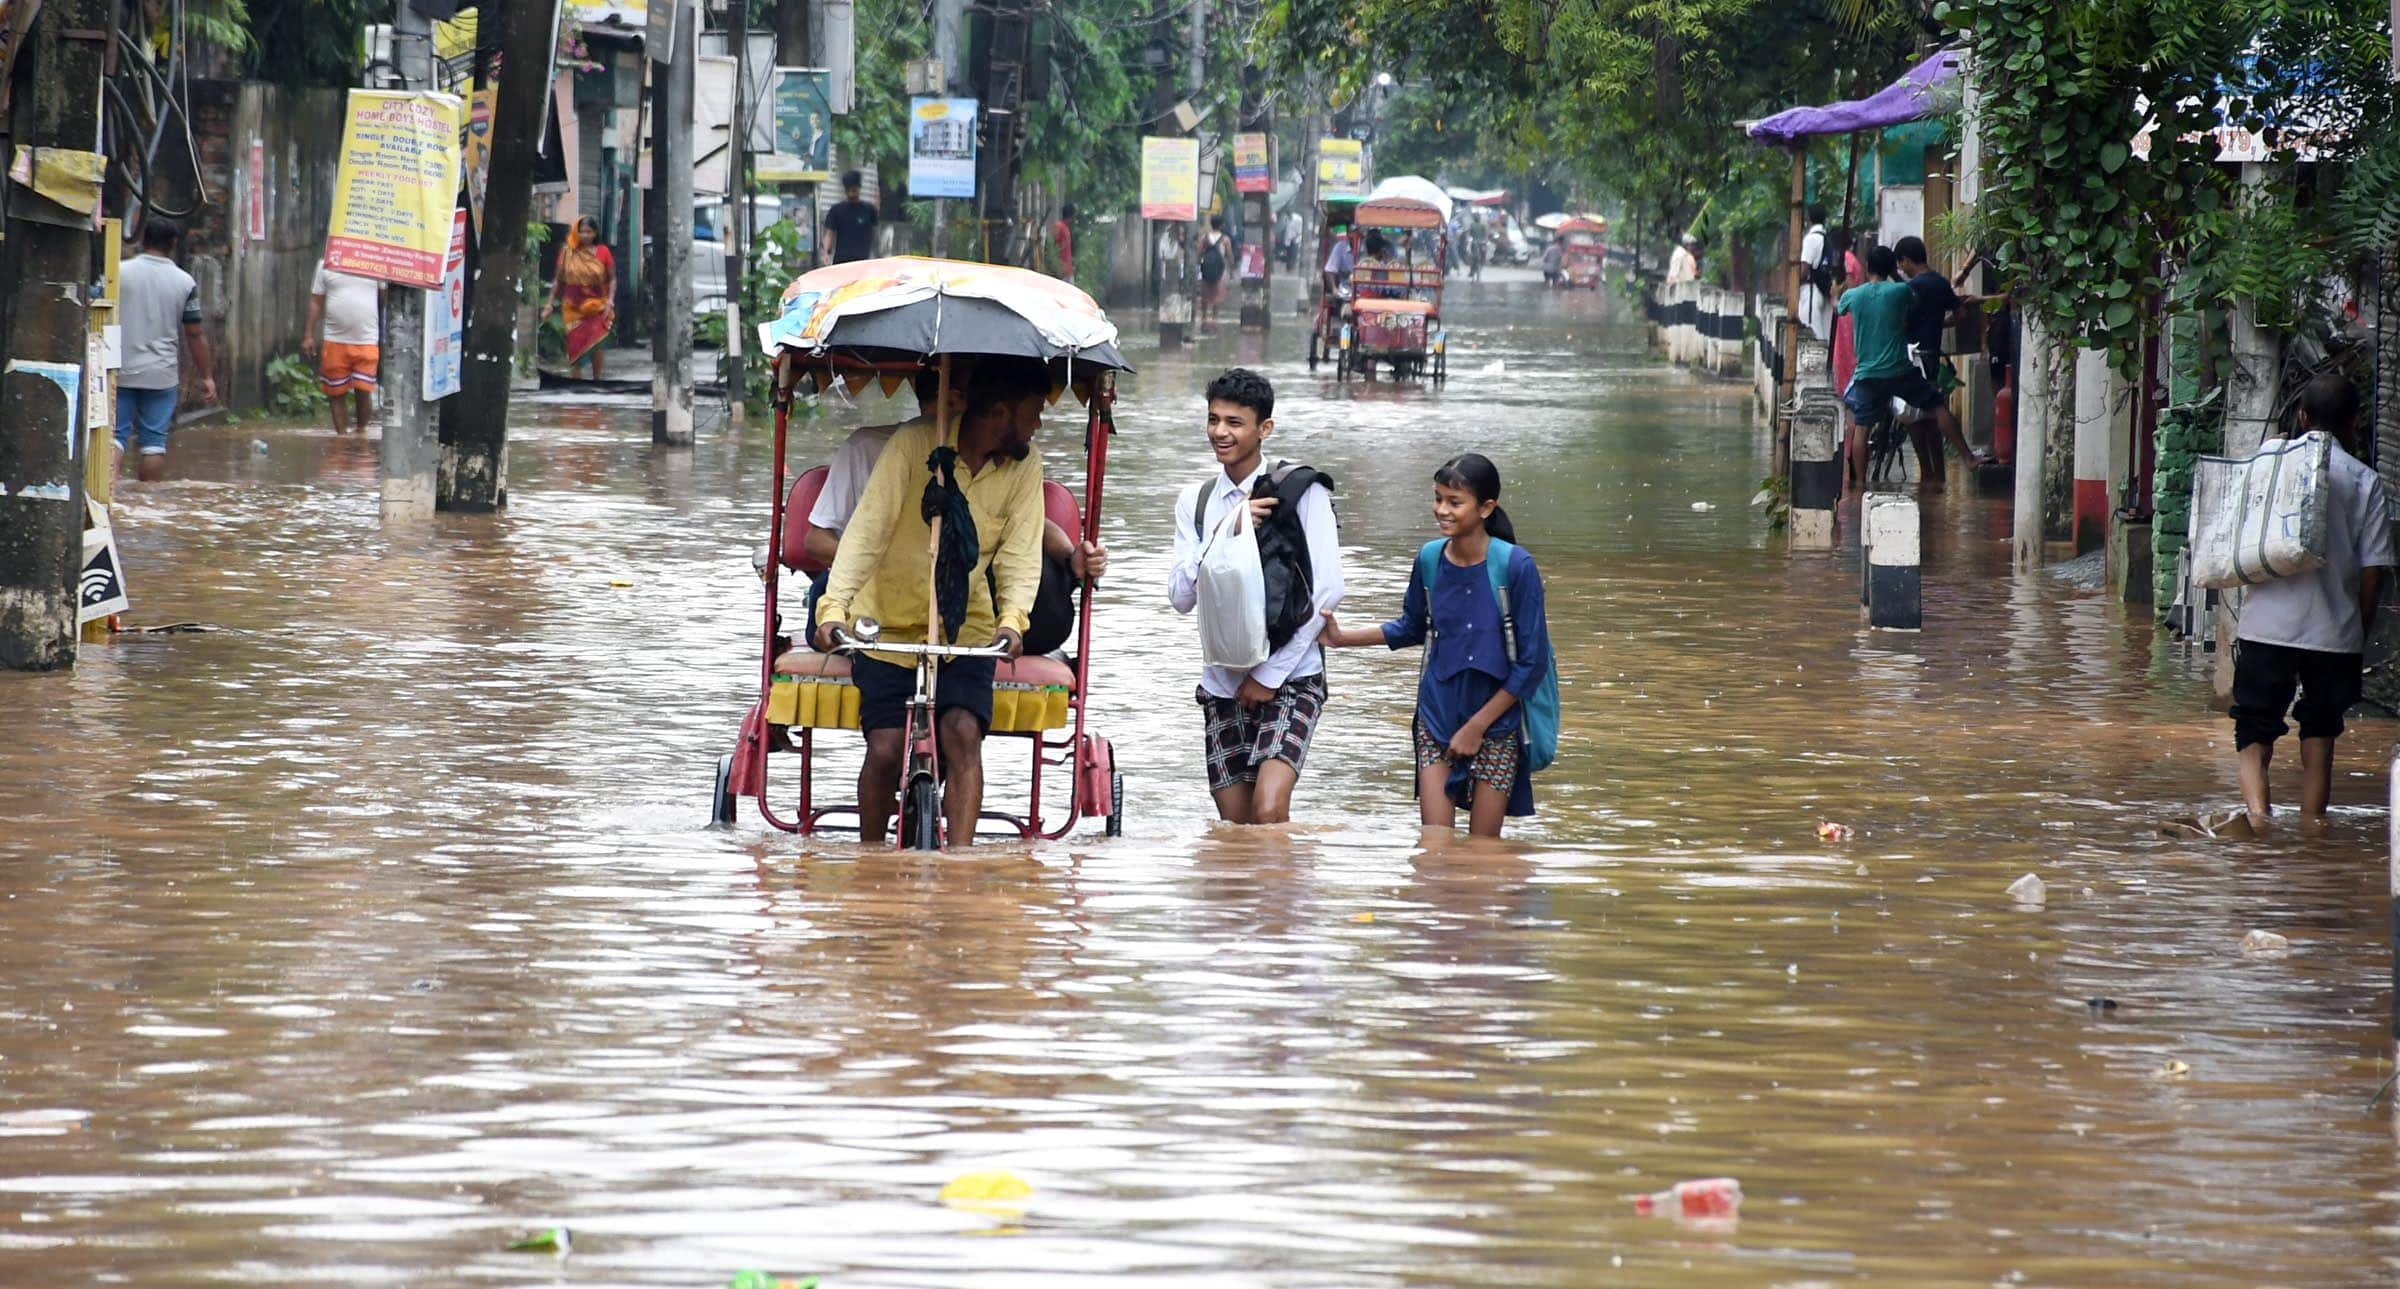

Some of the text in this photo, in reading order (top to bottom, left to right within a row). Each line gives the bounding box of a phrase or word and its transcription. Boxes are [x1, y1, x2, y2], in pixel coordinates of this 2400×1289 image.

[382, 100, 436, 117] CITY COZY
[356, 110, 385, 121] HOME
[388, 112, 415, 124] BOYS
[416, 116, 452, 133] HOSTEL
[356, 132, 386, 142] SINGLE
[392, 136, 423, 146] DOUBLE
[380, 144, 423, 155] AVAILABLE
[358, 170, 391, 179] WEEKLY
[394, 174, 417, 184] FOOD
